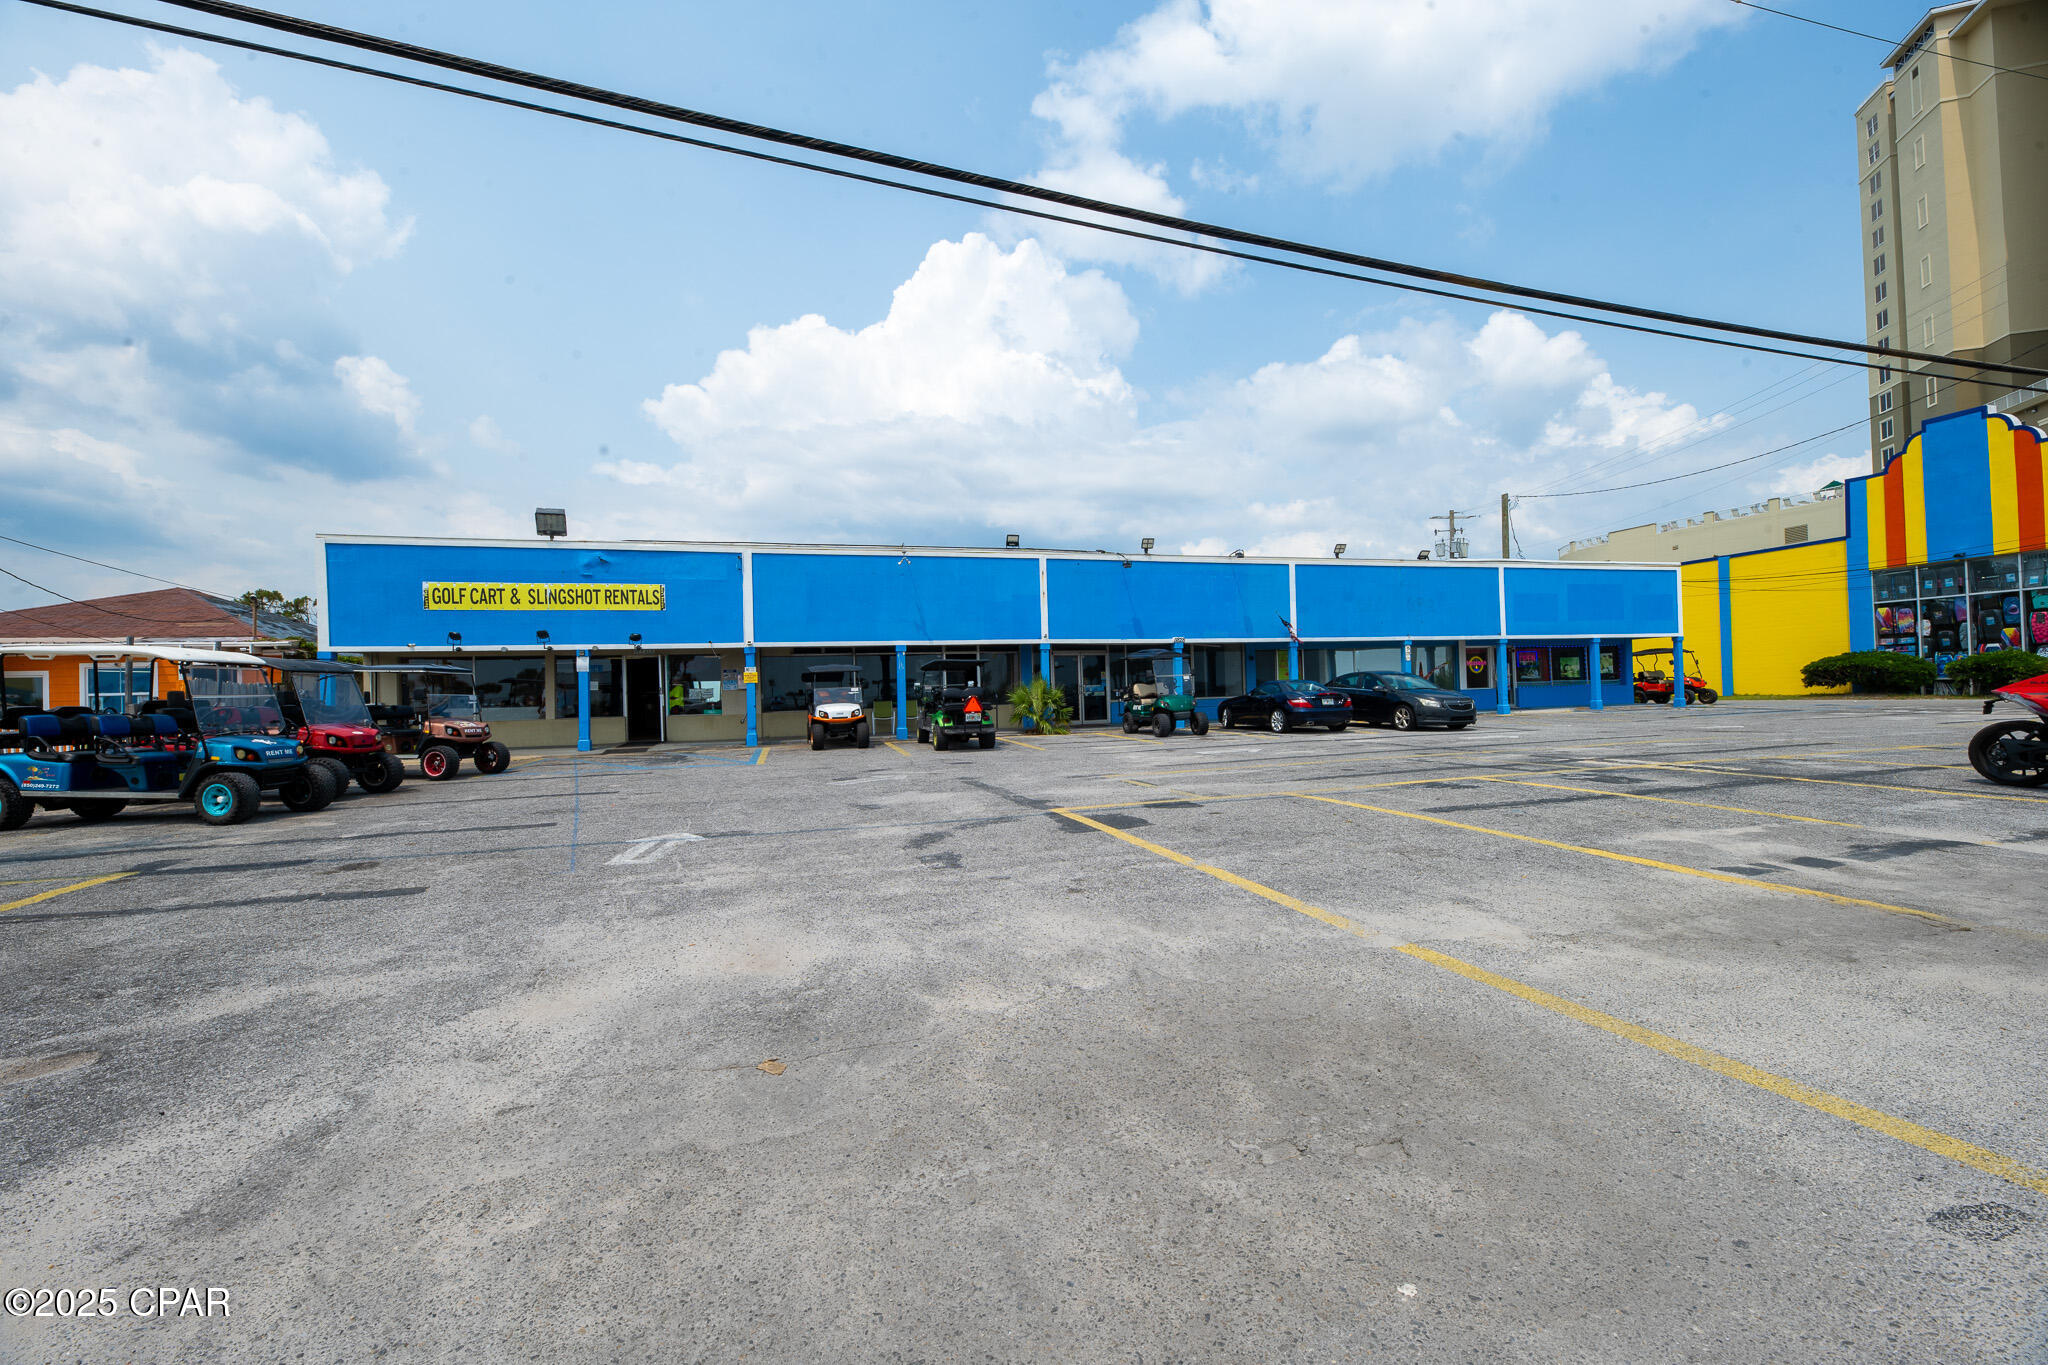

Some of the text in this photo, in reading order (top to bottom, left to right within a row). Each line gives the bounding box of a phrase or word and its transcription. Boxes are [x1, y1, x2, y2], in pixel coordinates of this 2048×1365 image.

[431, 587, 466, 605] GOLF
[470, 588, 505, 605] CART
[510, 589, 521, 605] &
[528, 588, 601, 606] SLINGSHOT
[604, 589, 660, 606] RENTALS
[265, 749, 283, 757] RENT
